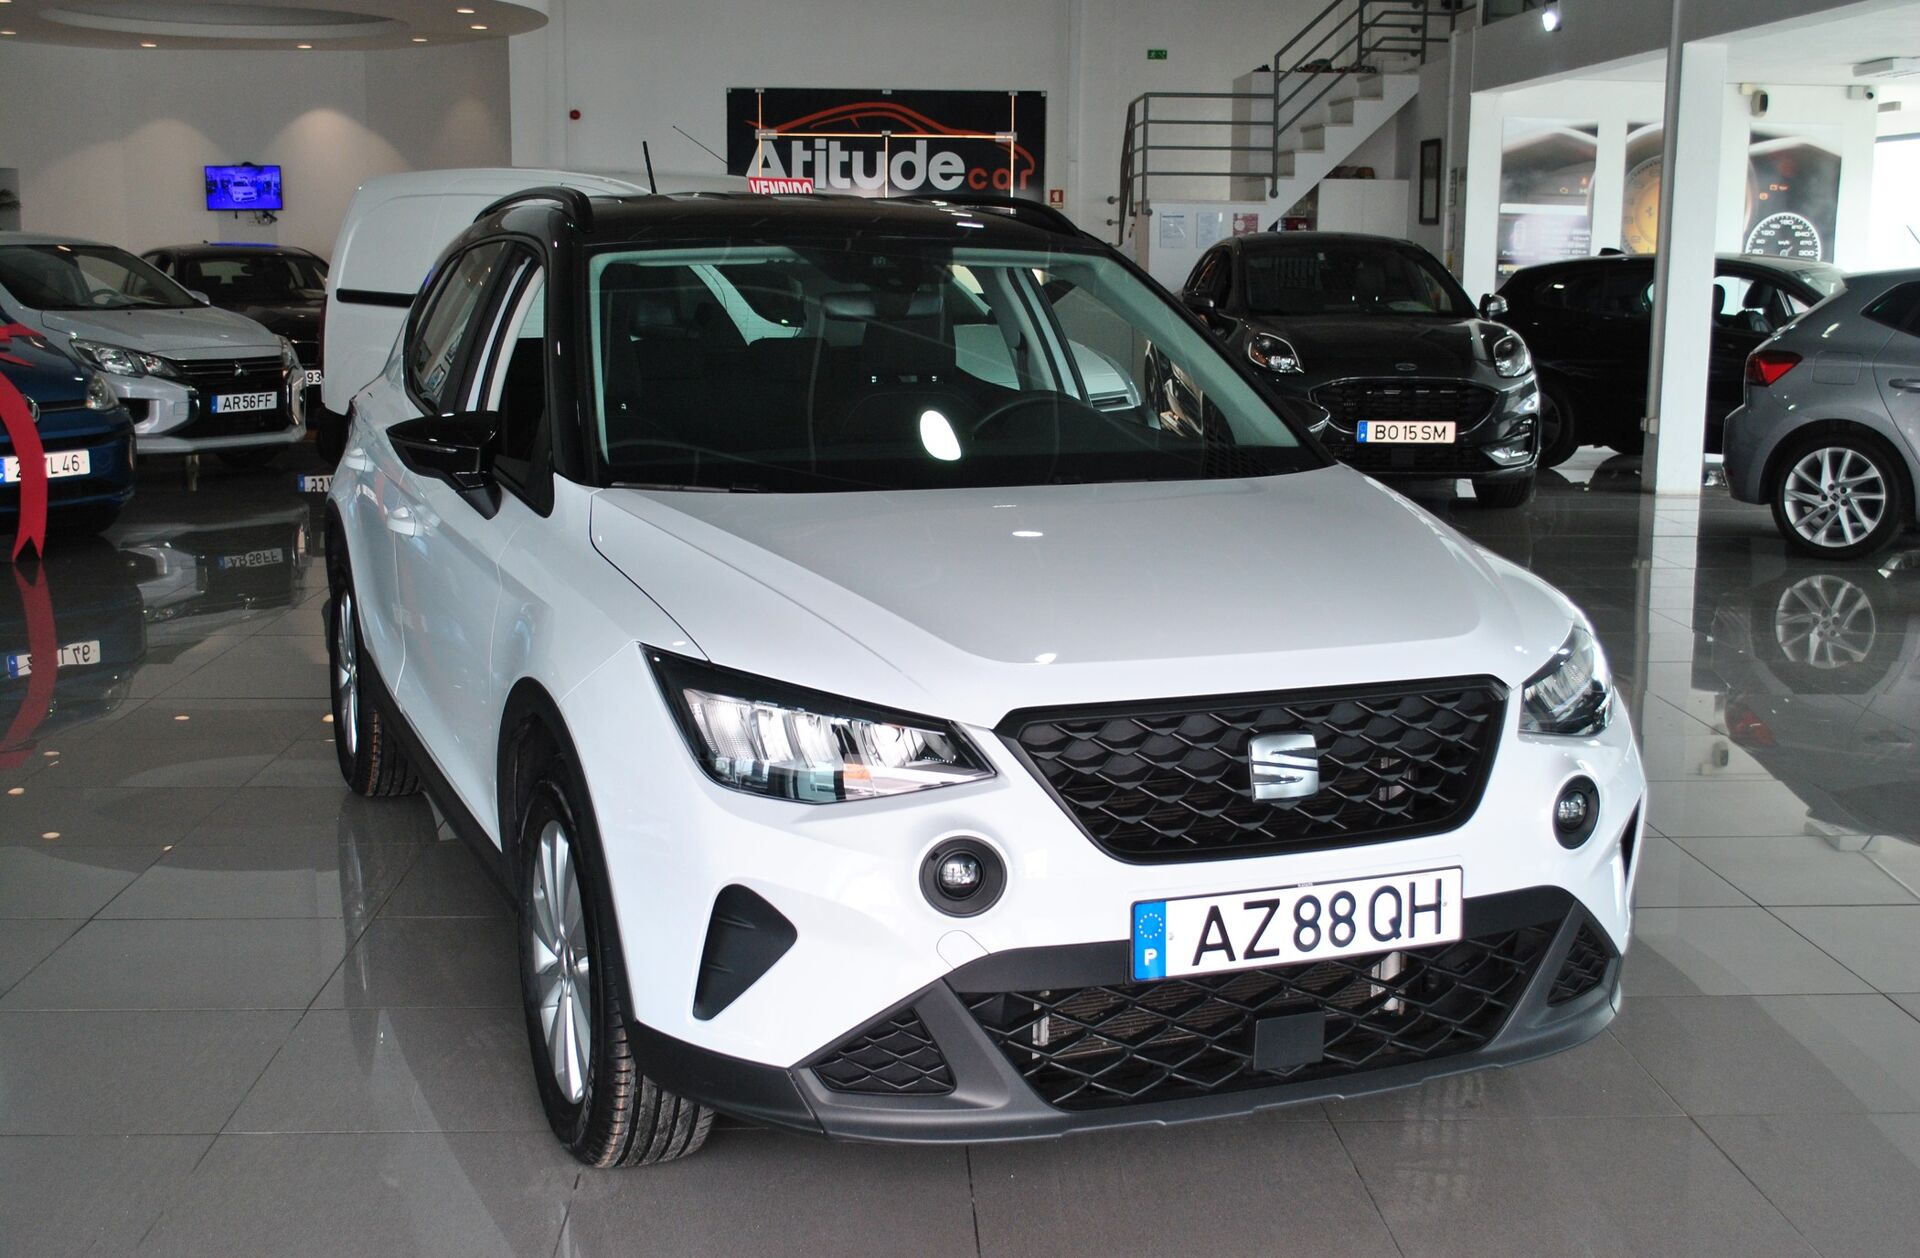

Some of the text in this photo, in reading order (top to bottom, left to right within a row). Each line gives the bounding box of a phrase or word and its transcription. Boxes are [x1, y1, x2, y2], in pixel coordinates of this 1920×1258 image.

[746, 138, 1034, 191] Atitude car
[1191, 898, 1281, 967] AZ
[1292, 890, 1357, 953] 88
[1367, 878, 1443, 943] QH
